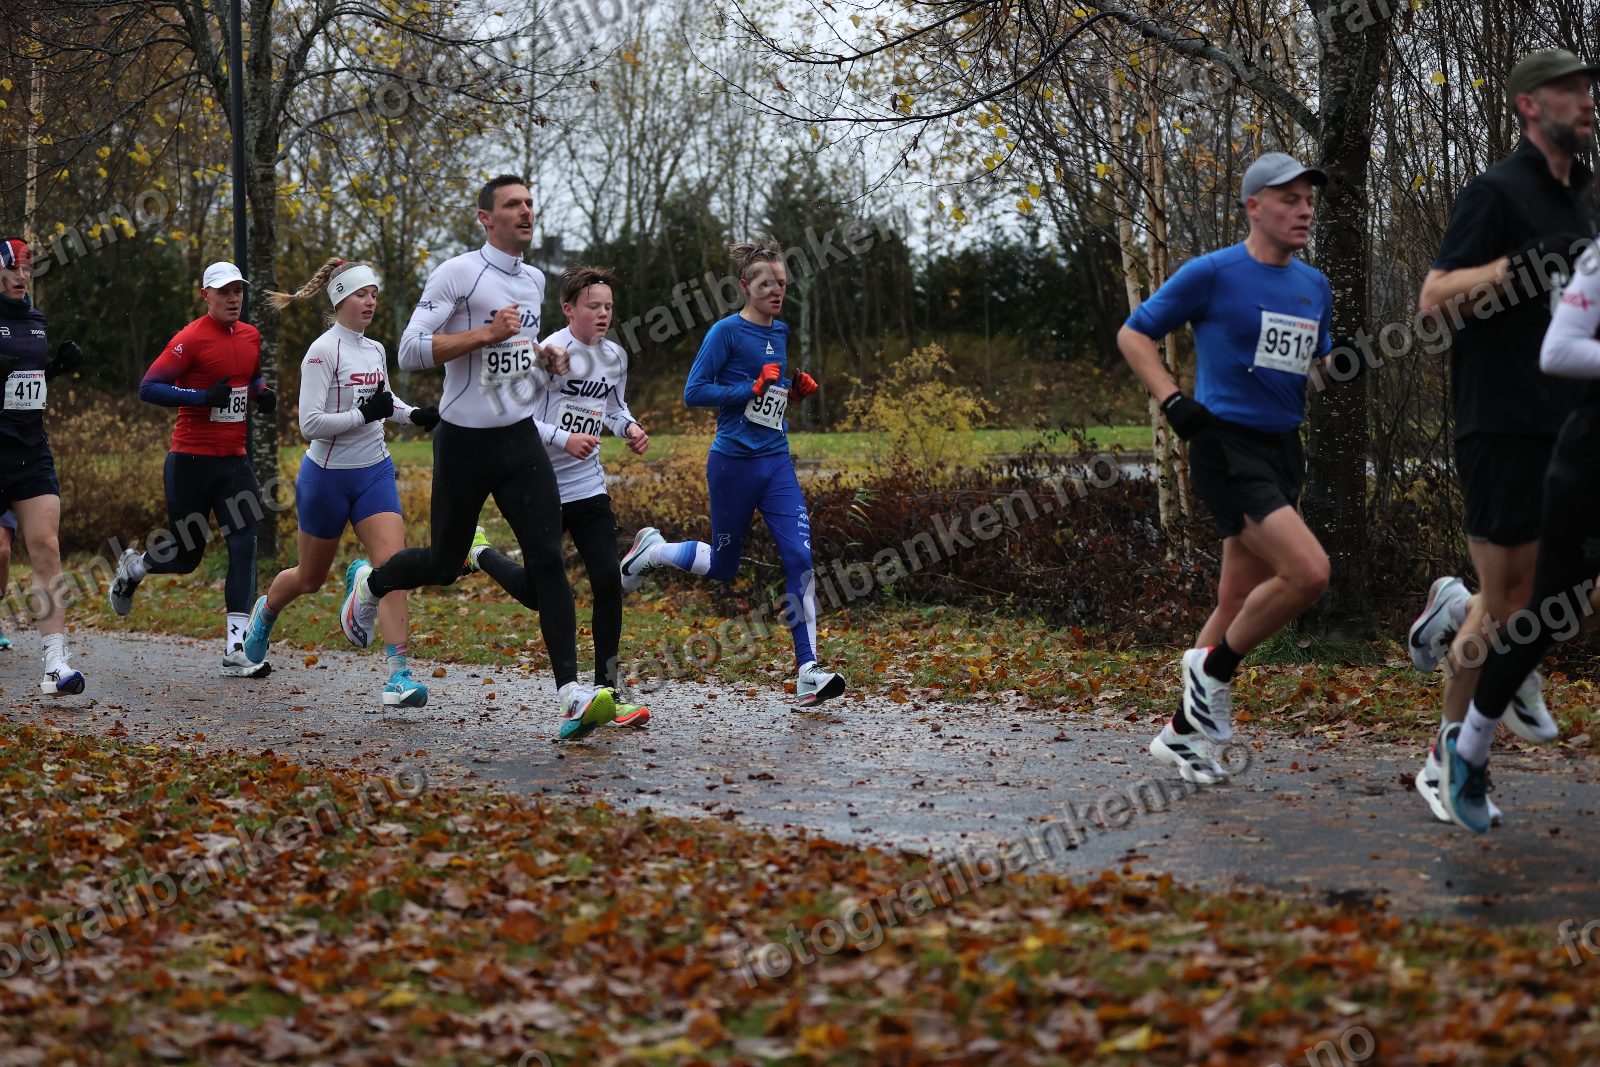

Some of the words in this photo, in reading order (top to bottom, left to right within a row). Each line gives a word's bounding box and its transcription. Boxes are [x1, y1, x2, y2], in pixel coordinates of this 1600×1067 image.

[1265, 327, 1314, 361] 9513
[487, 349, 532, 374] 9515
[15, 381, 41, 400] 417
[752, 396, 786, 418] 9514
[559, 412, 602, 437] 9508
